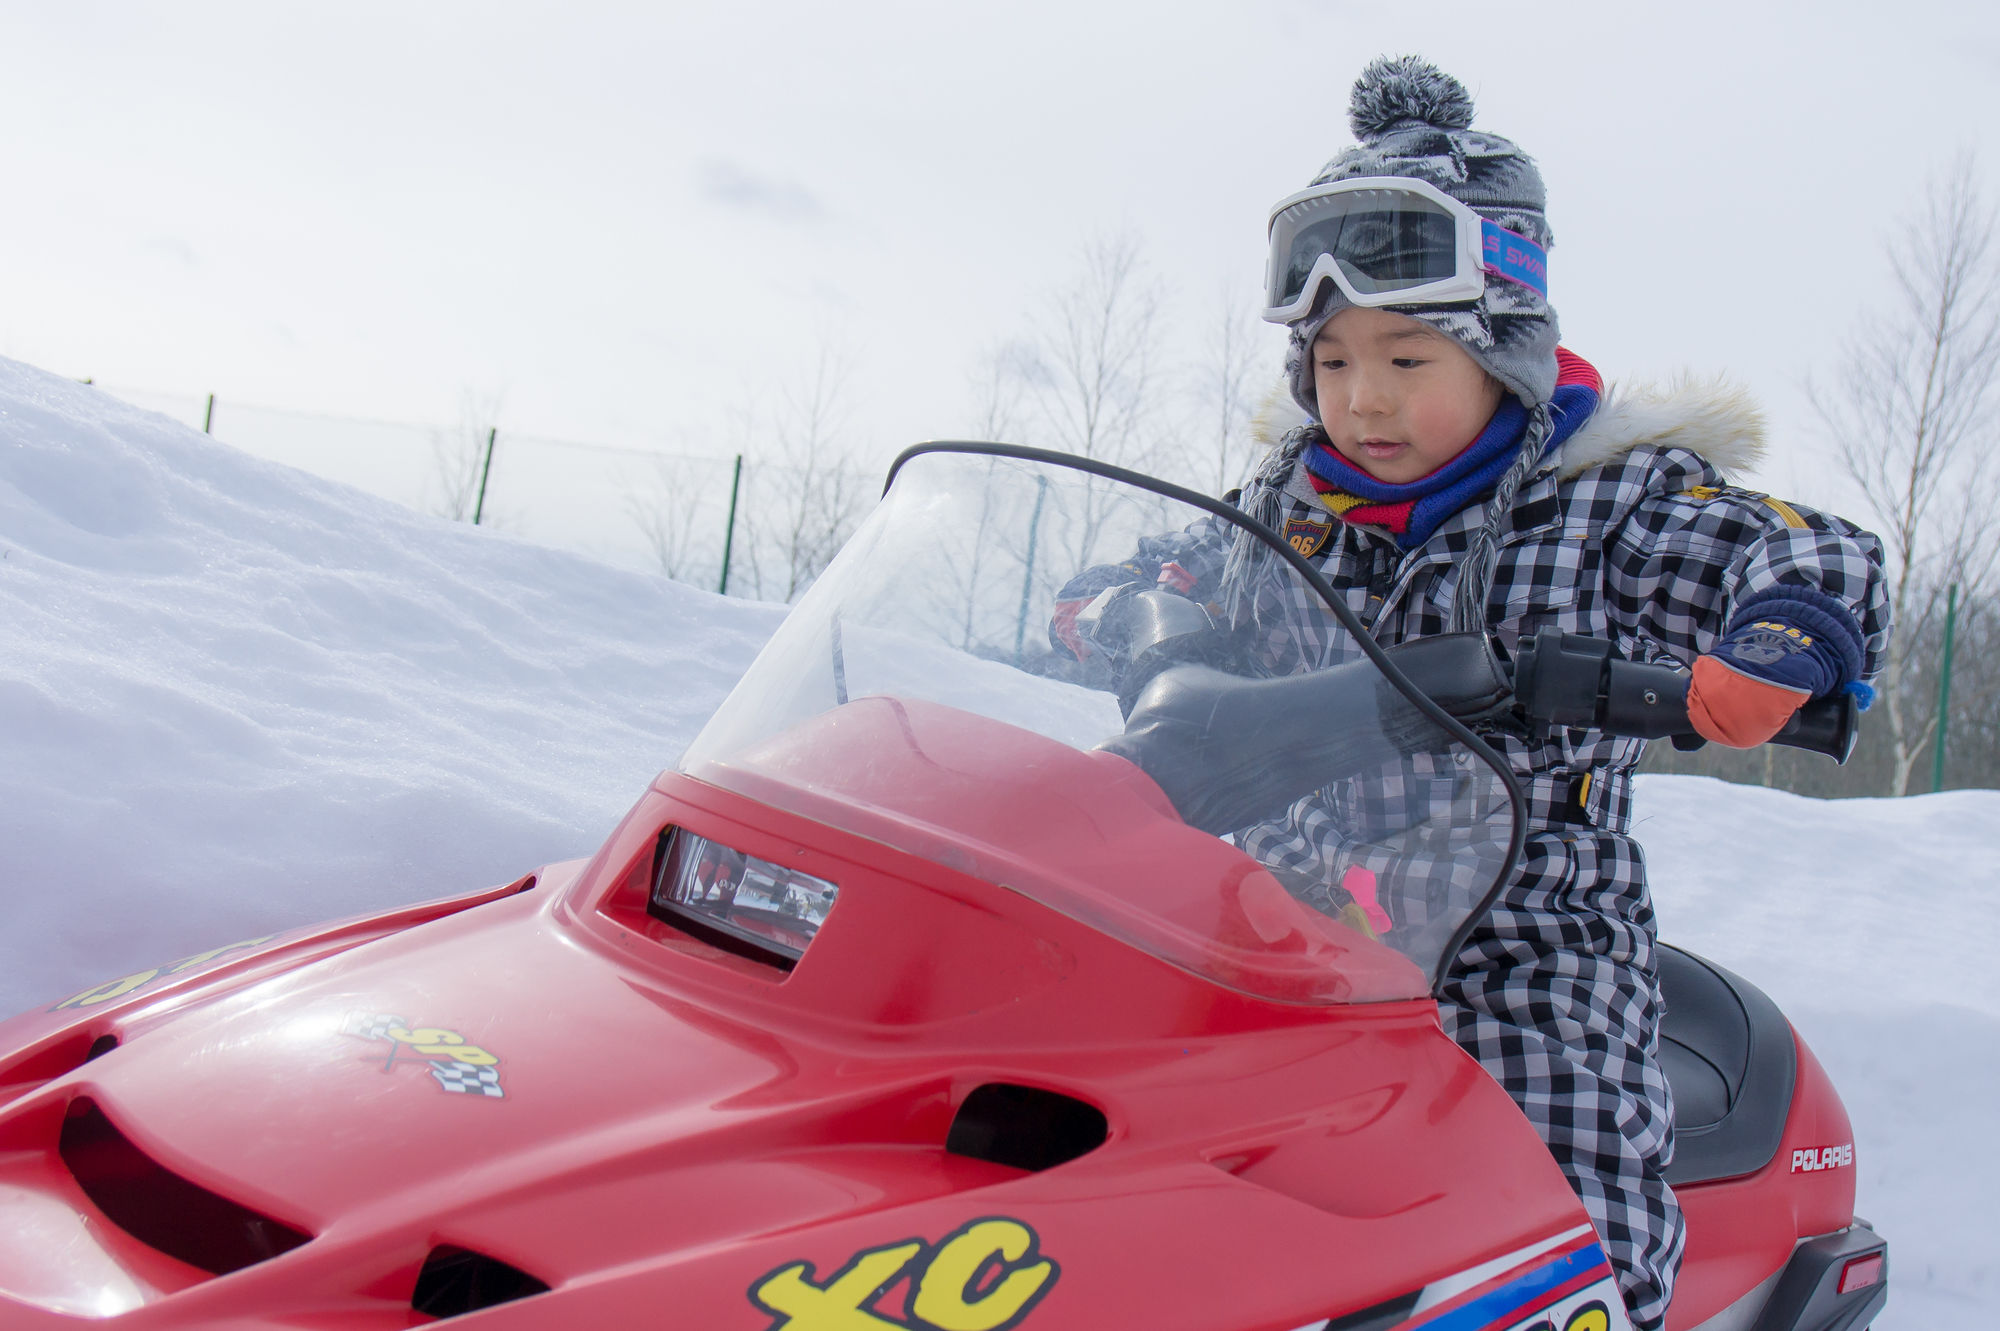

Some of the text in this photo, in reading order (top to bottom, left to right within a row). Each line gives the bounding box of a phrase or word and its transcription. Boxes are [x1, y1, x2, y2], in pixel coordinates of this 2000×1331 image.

[1289, 535, 1315, 555] 96
[387, 1027, 501, 1066] SP
[1791, 1144, 1852, 1173] POLARIS
[748, 1216, 1061, 1331] XC
